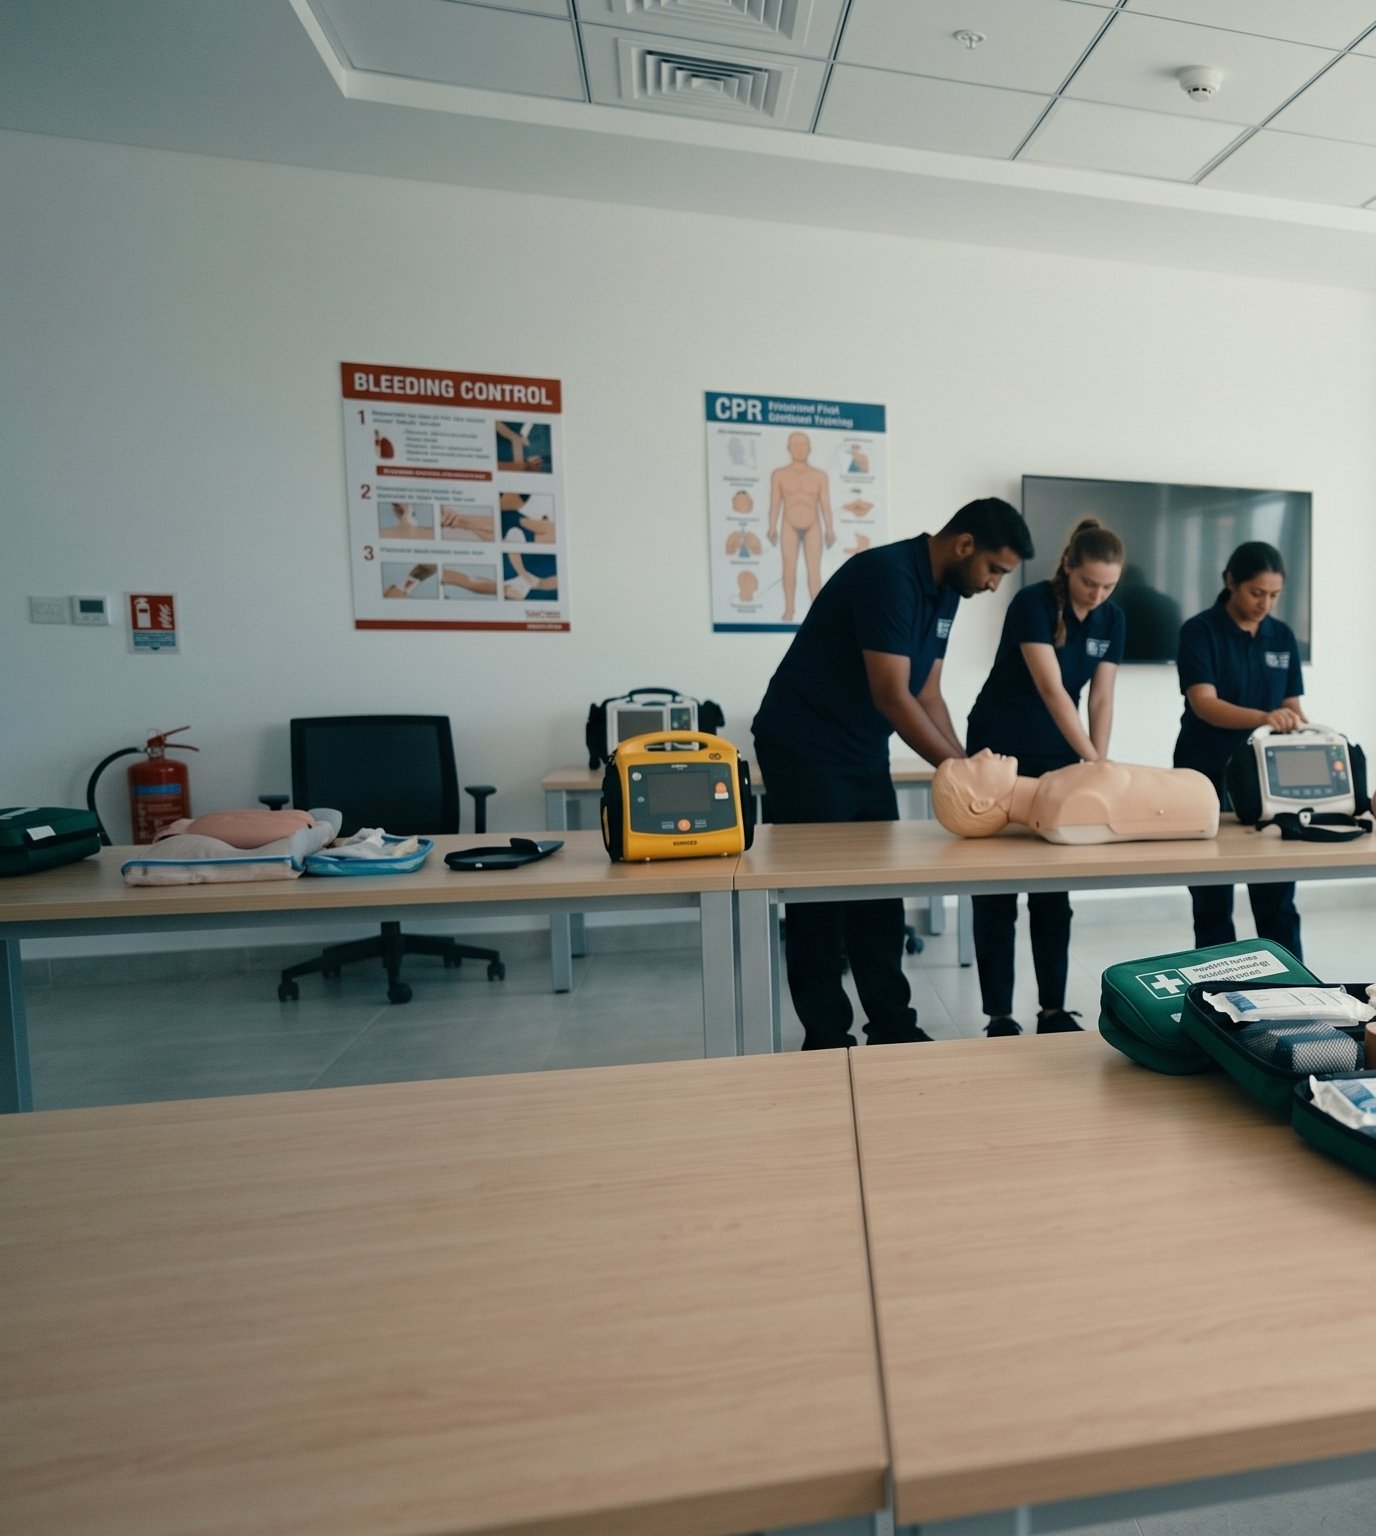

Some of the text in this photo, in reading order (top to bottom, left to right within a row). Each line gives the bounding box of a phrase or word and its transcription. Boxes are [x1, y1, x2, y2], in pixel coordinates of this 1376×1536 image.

[354, 372, 553, 406] BLEEDING CONTROL
[715, 396, 763, 421] CPR
[357, 409, 366, 425] 1
[360, 484, 371, 500] 2
[363, 545, 375, 561] 3
